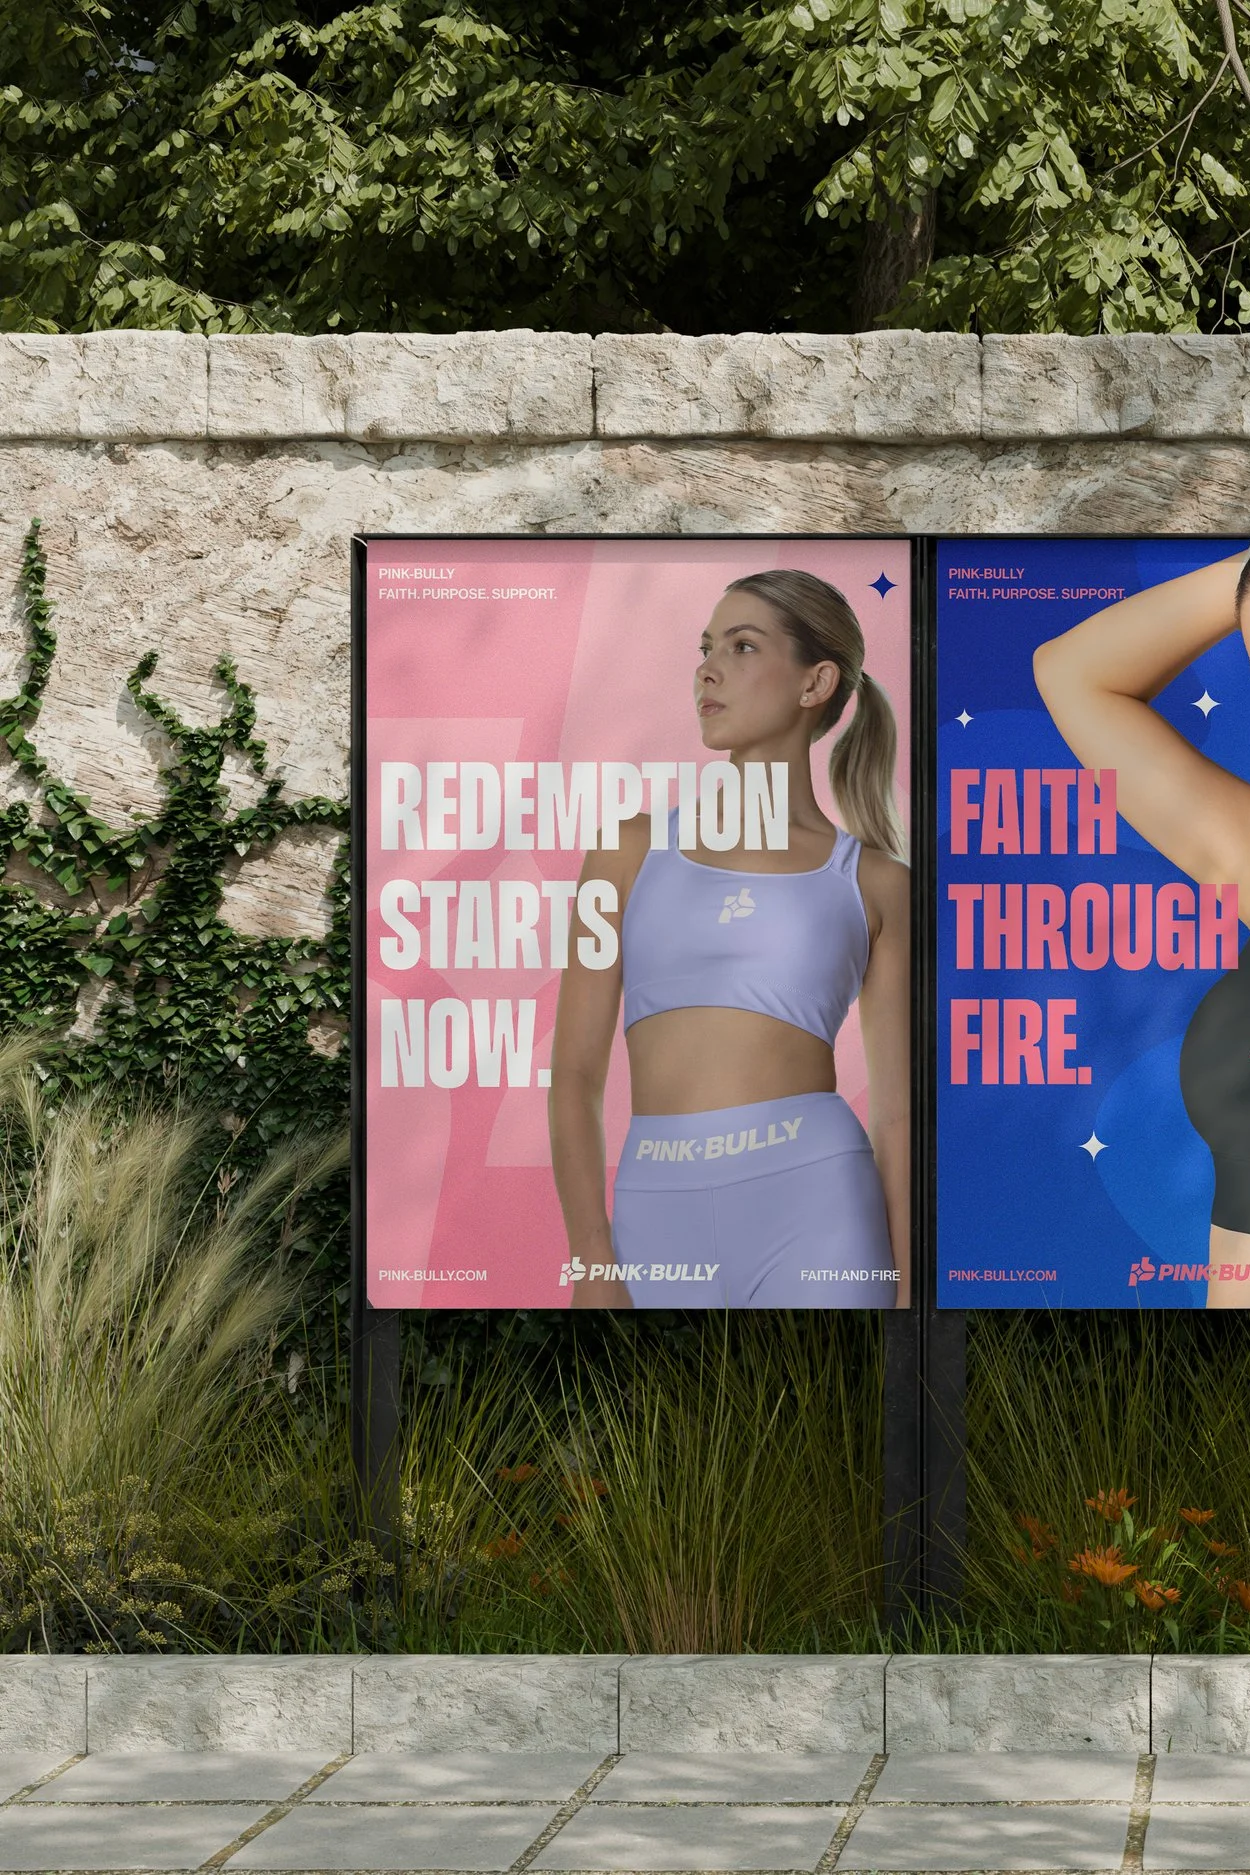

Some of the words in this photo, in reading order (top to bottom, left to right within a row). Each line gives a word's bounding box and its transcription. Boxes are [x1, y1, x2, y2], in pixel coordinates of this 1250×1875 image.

[379, 568, 455, 579] PINK-BULLY
[949, 568, 1025, 579] PINK-BULLY
[379, 588, 420, 600] FAITH.
[423, 588, 489, 600] PURPOSE.
[491, 588, 557, 600] SUPPORT.
[949, 588, 990, 600] FAITH.
[993, 588, 1059, 600] PURPOSE.
[1061, 588, 1127, 600] SUPPORT.
[380, 762, 789, 851] REDEMPTION
[950, 768, 1118, 855] FAITH
[379, 880, 619, 971] STARTS
[948, 883, 1239, 971] THROUGH
[380, 998, 552, 1088] NOW.
[950, 998, 1092, 1085] FIRE.
[379, 1269, 487, 1281] PINK-BULLY.COM
[801, 1270, 838, 1281] FAITH
[841, 1270, 868, 1281] AND
[871, 1270, 900, 1281] FIRE
[948, 1269, 1056, 1281] PINK-BULLY.COM
